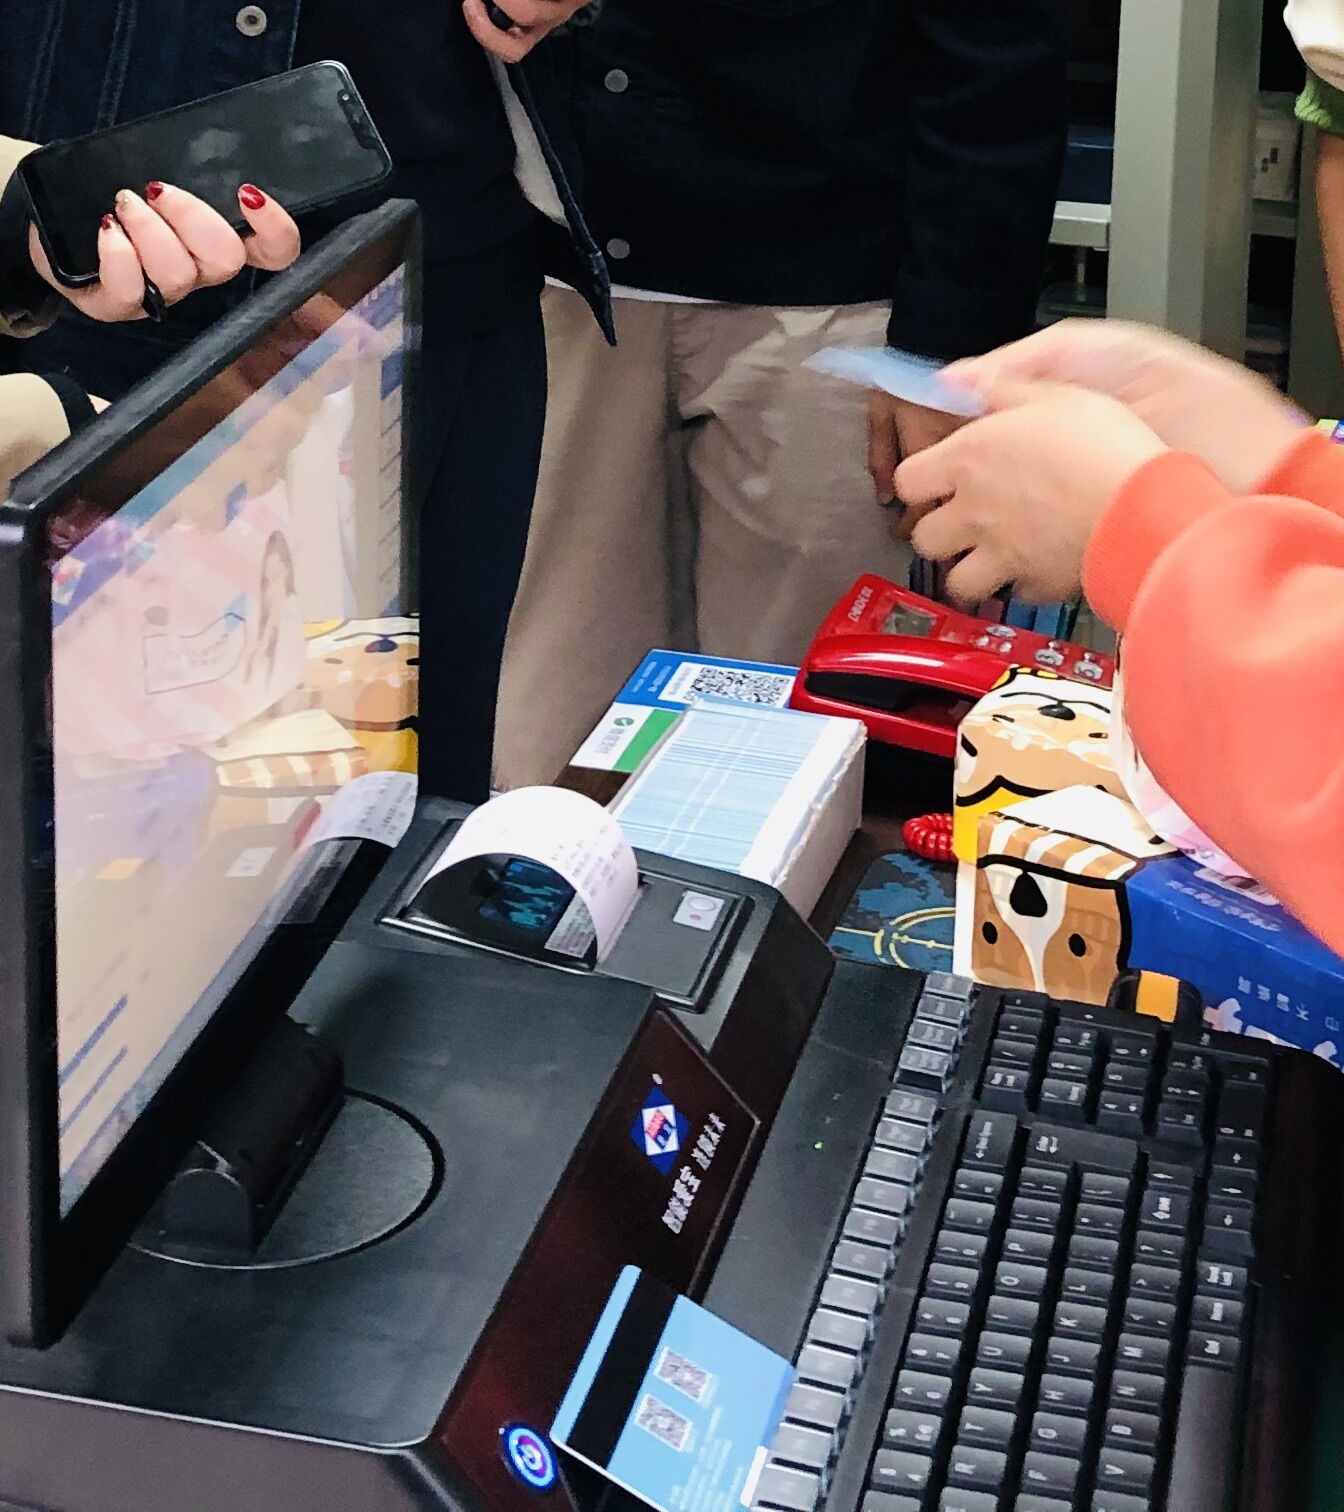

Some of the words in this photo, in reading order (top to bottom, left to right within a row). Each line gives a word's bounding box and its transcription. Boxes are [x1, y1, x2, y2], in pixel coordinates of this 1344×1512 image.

[1058, 1317, 1078, 1328] K
[985, 1346, 1002, 1357] U
[1122, 1346, 1144, 1358] M
[1052, 1353, 1070, 1363] J
[975, 1382, 993, 1393] Y
[1118, 1385, 1137, 1396] N
[1045, 1389, 1065, 1401] H
[964, 1421, 984, 1433] T
[954, 1462, 975, 1476] R
[1104, 1464, 1125, 1476] V
